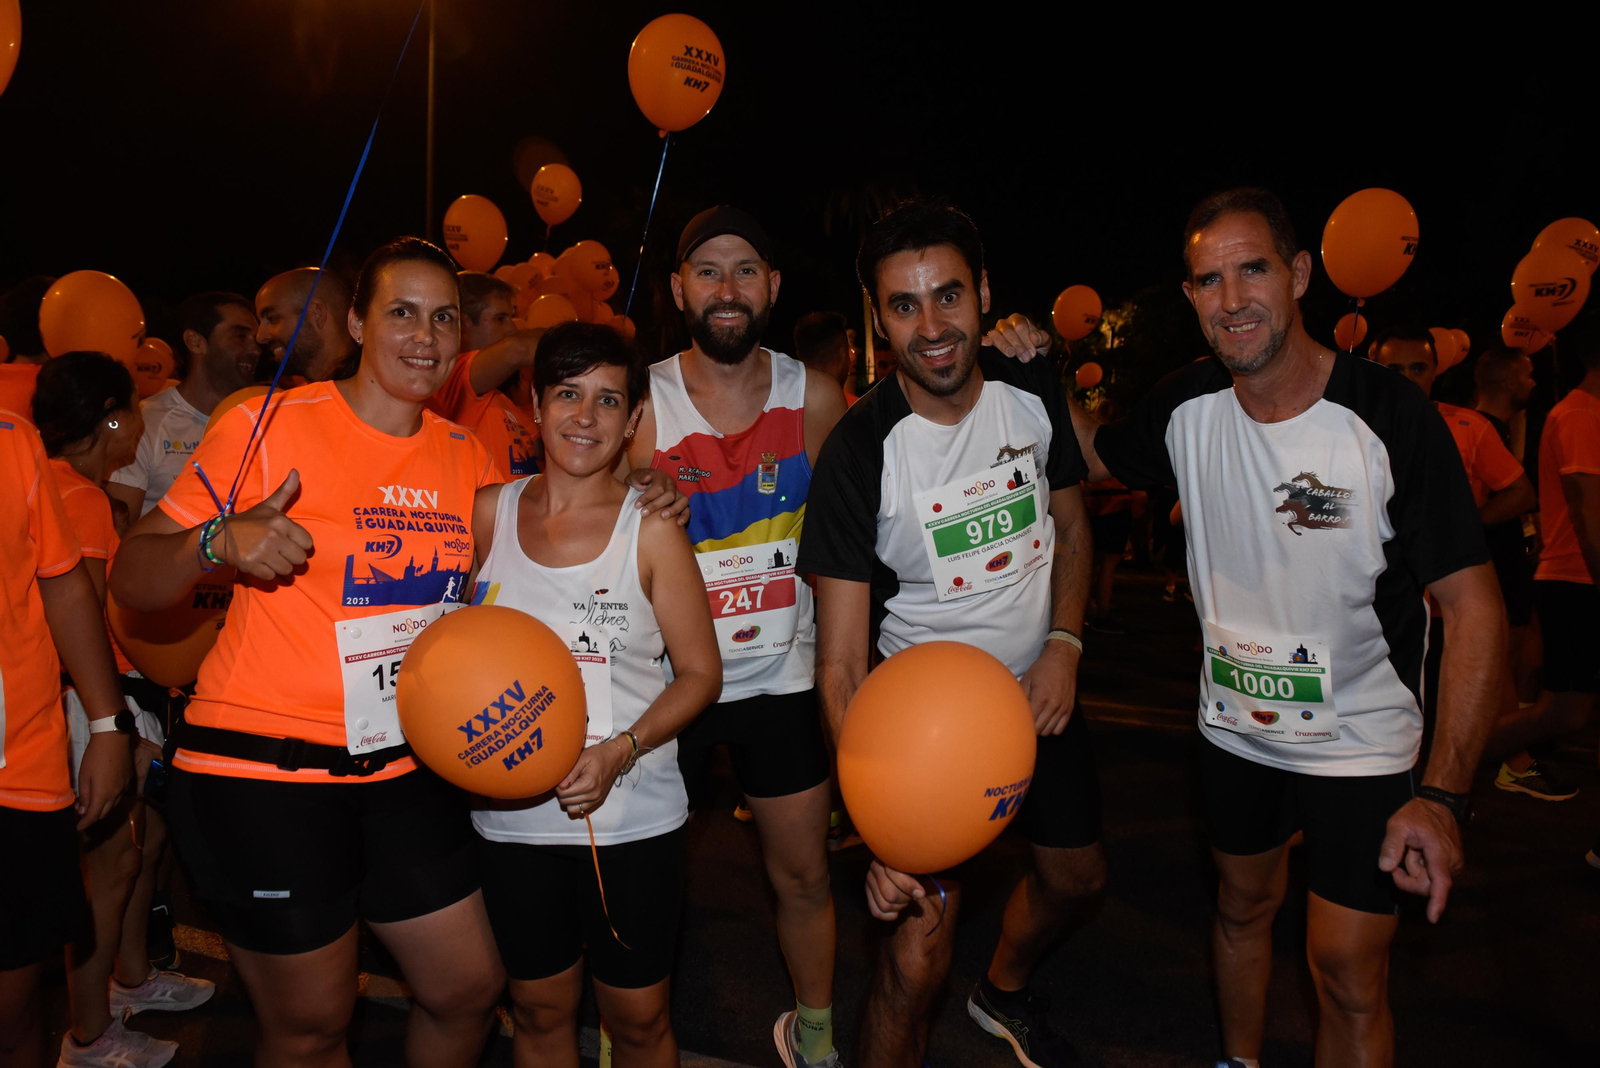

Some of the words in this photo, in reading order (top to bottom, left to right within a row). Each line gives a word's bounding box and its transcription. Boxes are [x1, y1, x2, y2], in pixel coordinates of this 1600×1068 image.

[684, 45, 719, 67] XXXV
[377, 485, 438, 509] XXXV
[1322, 502, 1337, 510] AL
[353, 507, 407, 518] CARRERA
[410, 510, 463, 523] NOCTURNA
[355, 516, 363, 529] DEL
[365, 518, 469, 535] GUADALQUIVIR
[966, 509, 1013, 545] 979
[947, 555, 961, 563] LUIS
[962, 548, 981, 559] FELIPE
[1005, 526, 1032, 545] DOMINGUEZ
[346, 597, 370, 605] 2023
[719, 585, 765, 614] 247
[347, 654, 363, 662] XXXV
[363, 650, 386, 660] CARRERA
[1230, 668, 1295, 699] 1000
[457, 680, 526, 744] XXXV
[458, 730, 502, 760] CARRERA
[501, 685, 549, 732] NOCTURNA
[470, 691, 556, 766] GUADALQUIVIR
